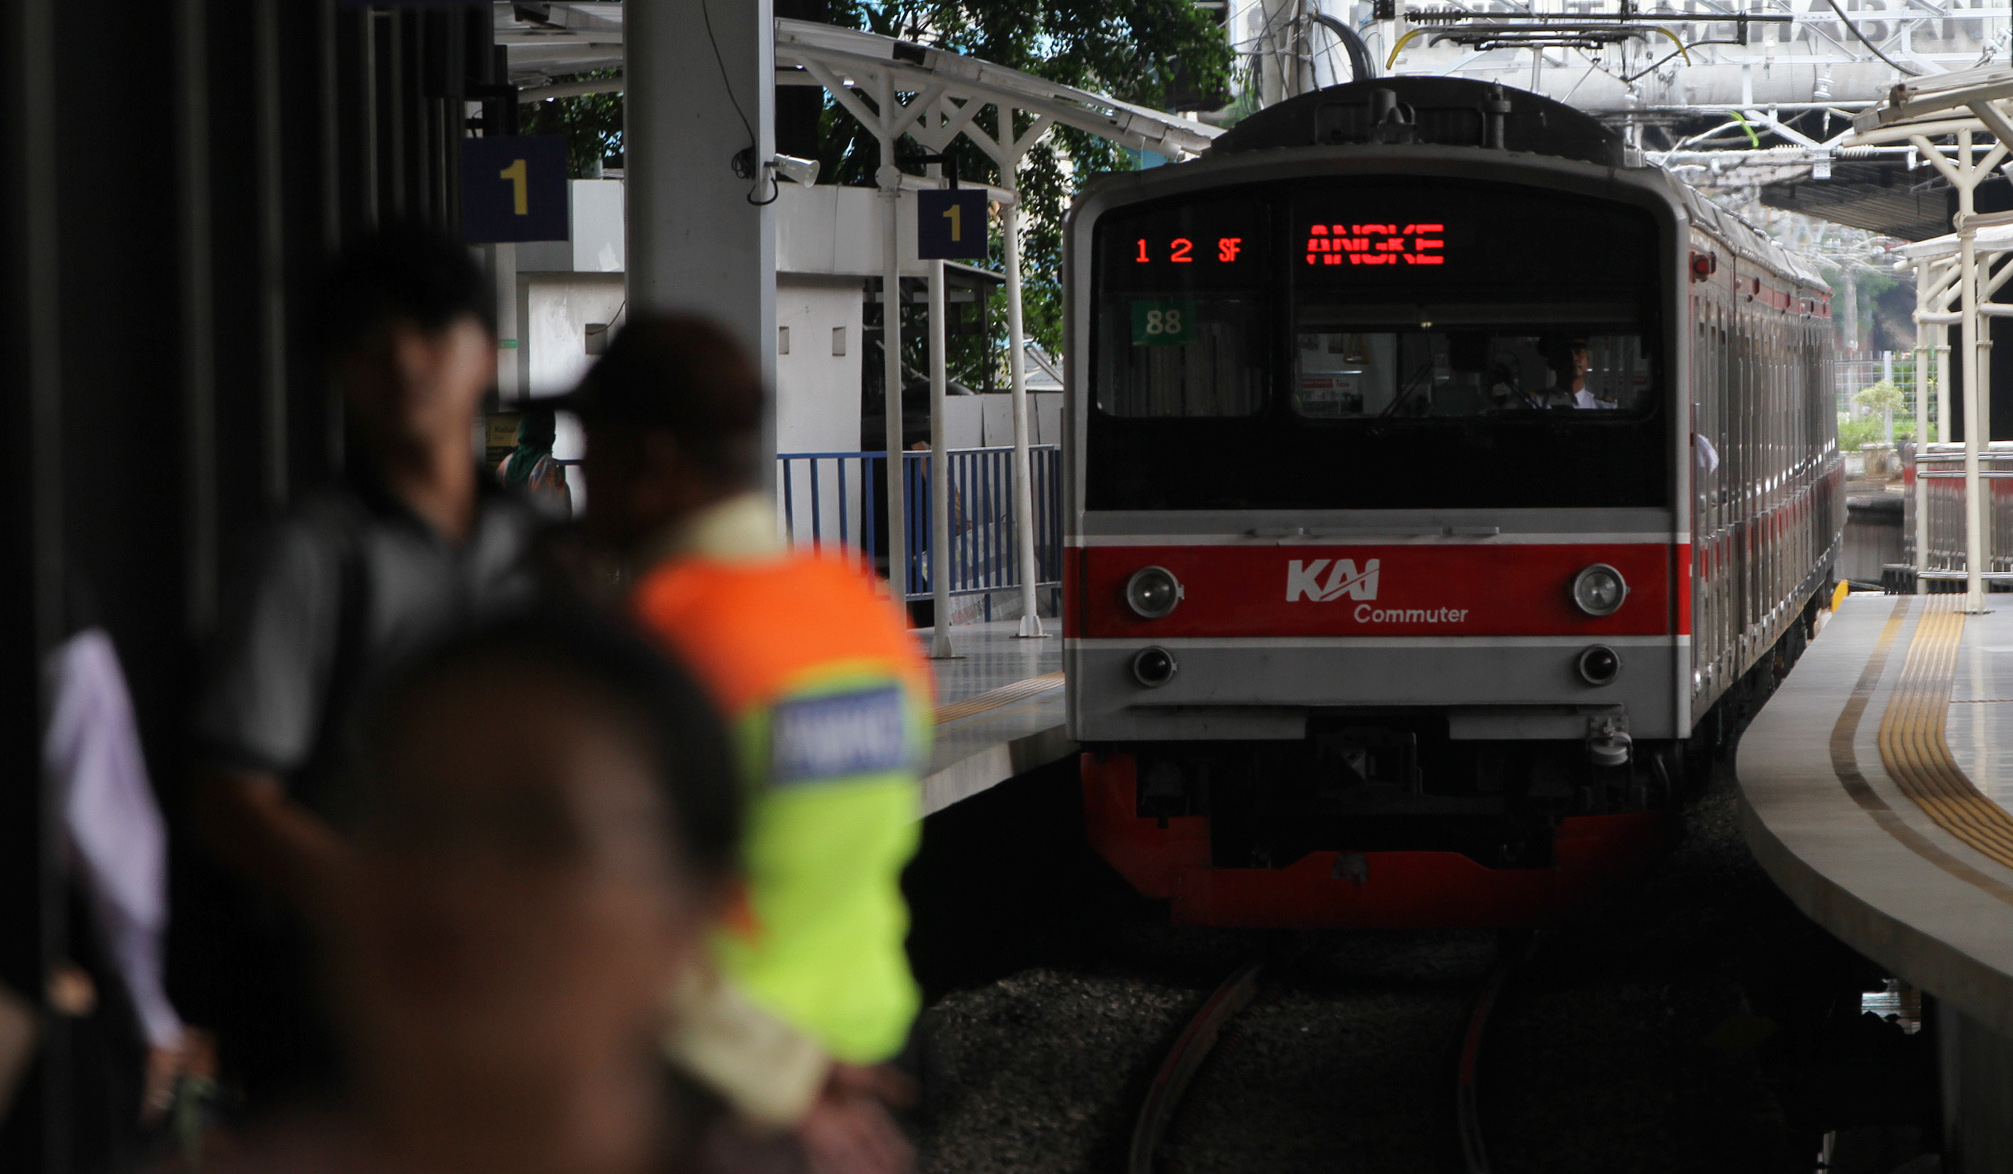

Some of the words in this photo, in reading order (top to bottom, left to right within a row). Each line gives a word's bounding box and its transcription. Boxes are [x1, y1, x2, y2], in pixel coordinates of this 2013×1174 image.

[500, 159, 528, 215] 1
[943, 204, 960, 241] 1
[1218, 238, 1242, 262] SF
[1306, 224, 1444, 264] ANGKE
[1146, 309, 1182, 335] 88
[1286, 558, 1380, 602] KAI
[1354, 604, 1469, 623] Commuter
